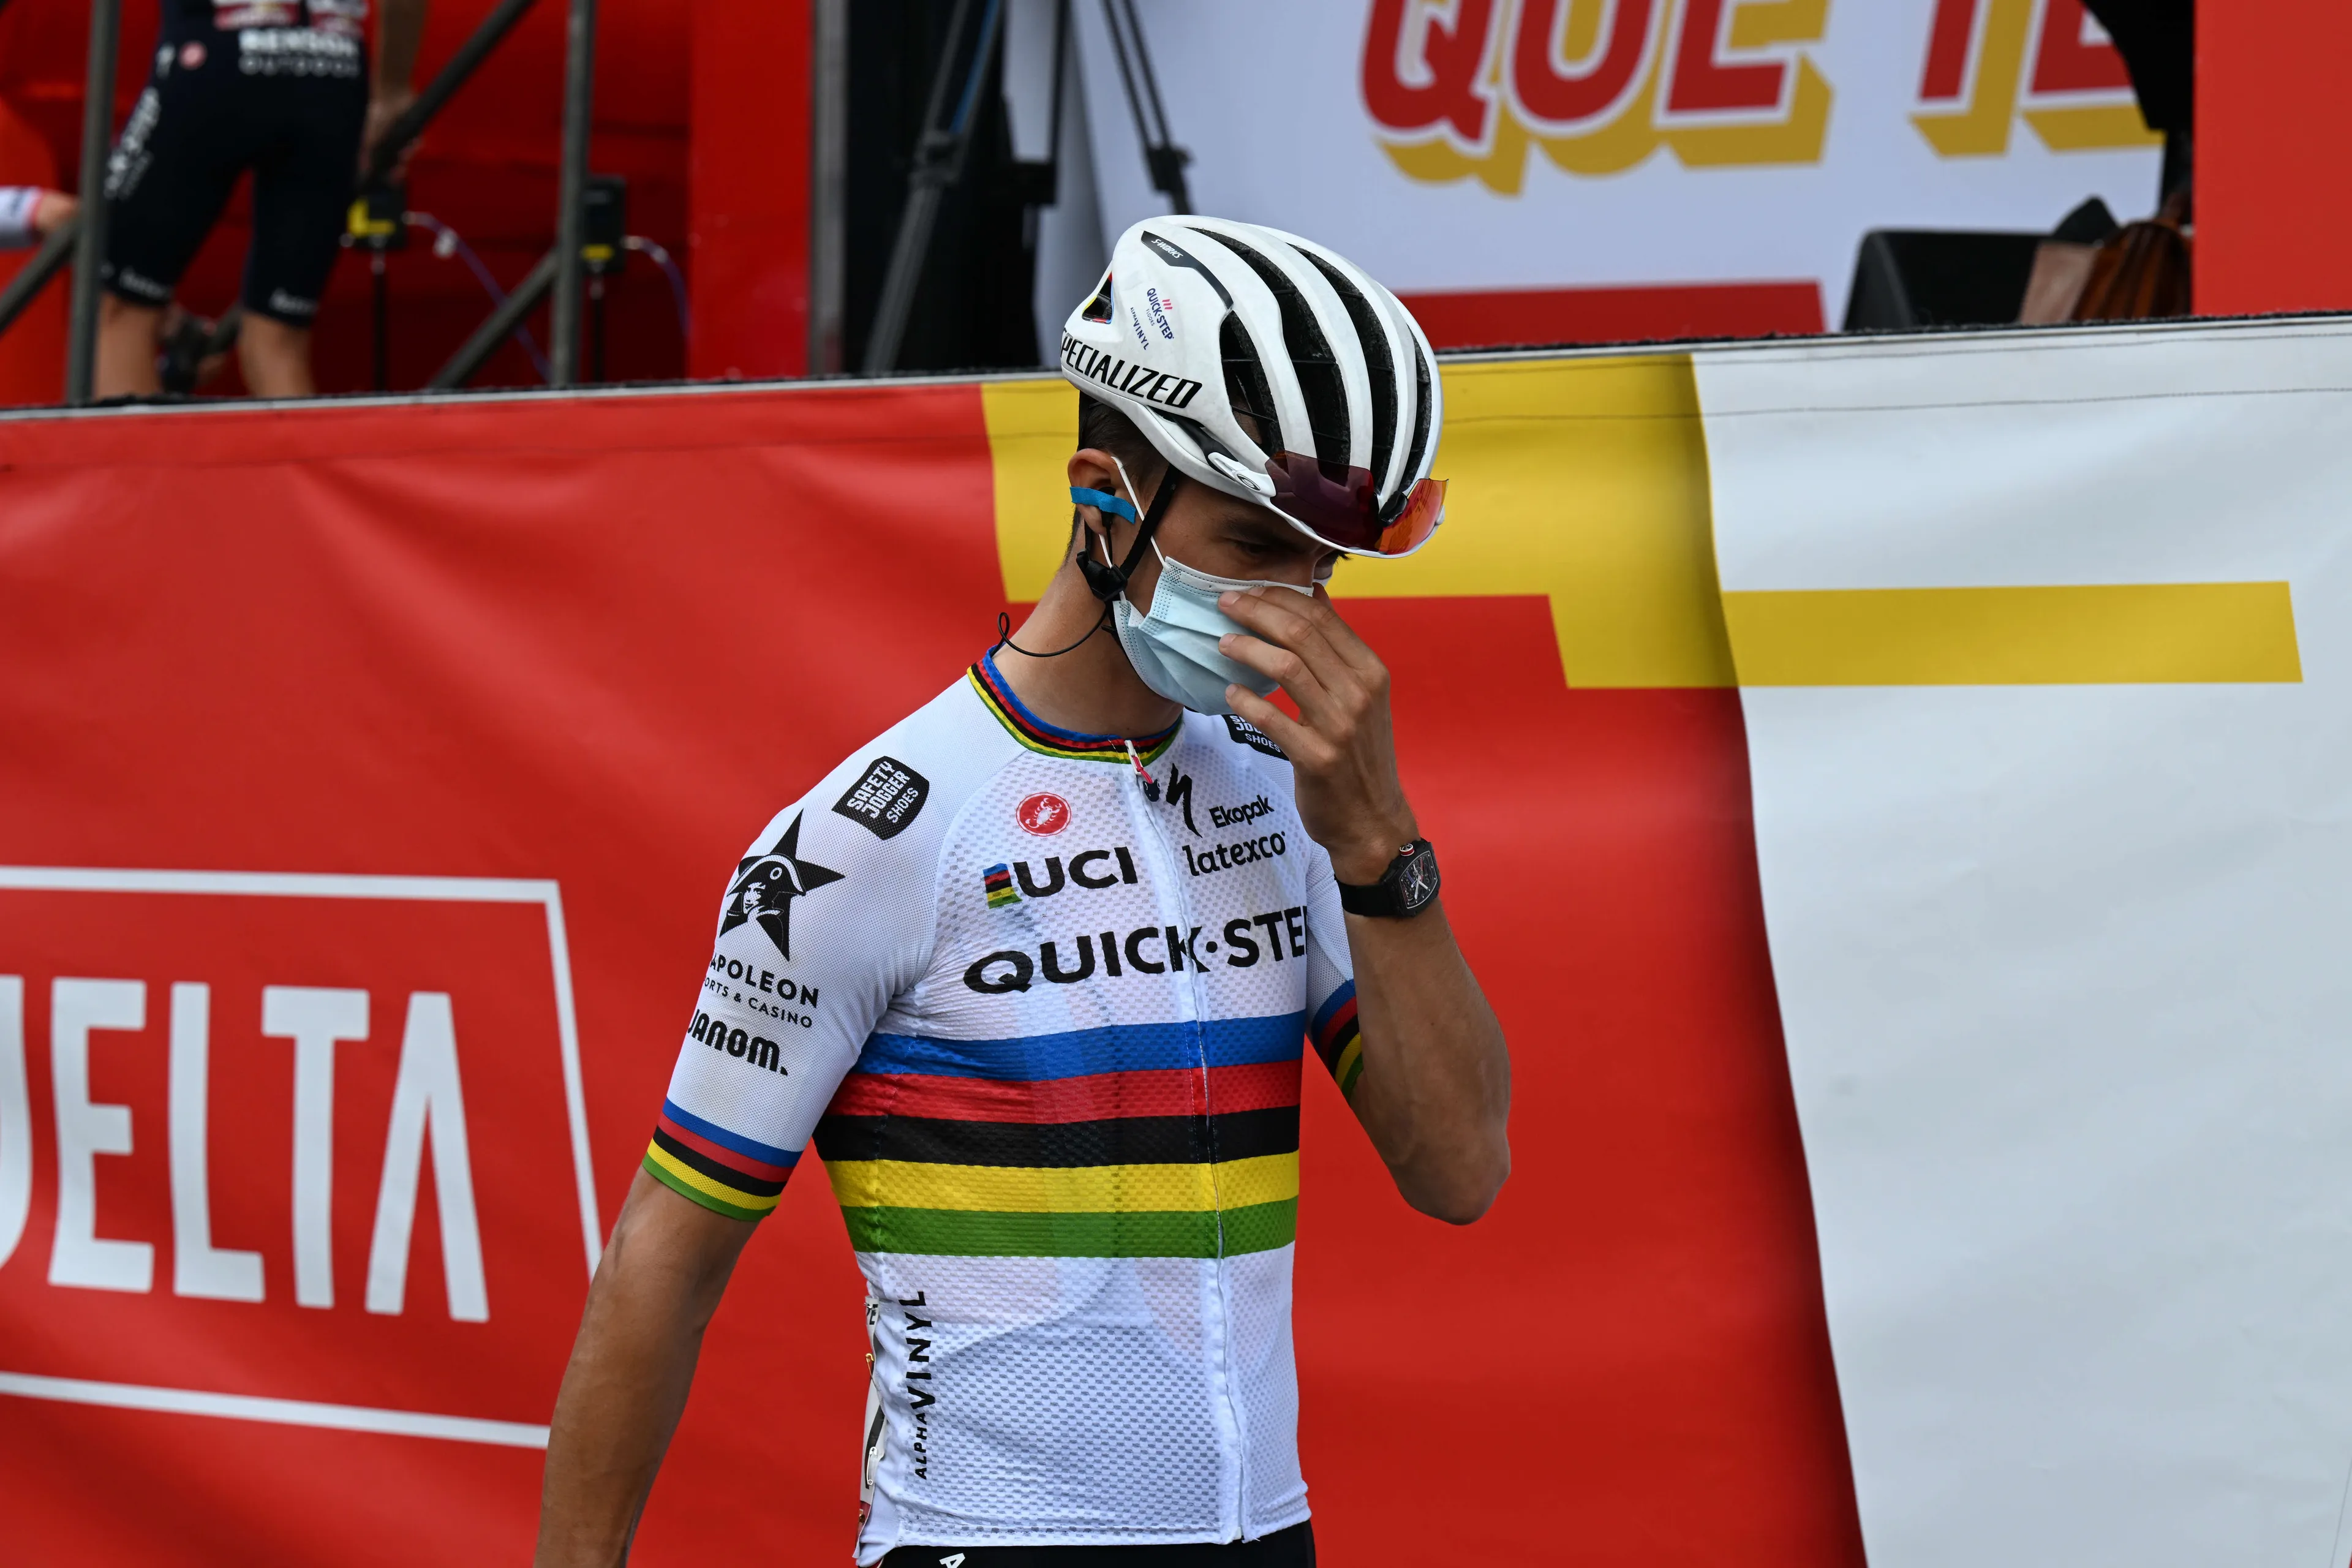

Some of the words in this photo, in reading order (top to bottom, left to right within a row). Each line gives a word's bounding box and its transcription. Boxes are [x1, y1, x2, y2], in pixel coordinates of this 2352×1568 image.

[1151, 238, 1184, 258] S-WORKS
[1146, 308, 1155, 326] FLOORS
[1060, 328, 1203, 409] PECIALIZED
[1245, 733, 1281, 753] SHOES
[846, 761, 895, 810] SAFETY
[861, 771, 910, 819] JOGGER
[886, 787, 918, 823] SHOES
[1208, 794, 1275, 828] Ekopak
[1012, 846, 1138, 898] UCI
[1182, 832, 1286, 876] latexco
[963, 905, 1307, 994] QUICK·STE
[734, 993, 742, 1003] &
[748, 997, 812, 1028] CASINO
